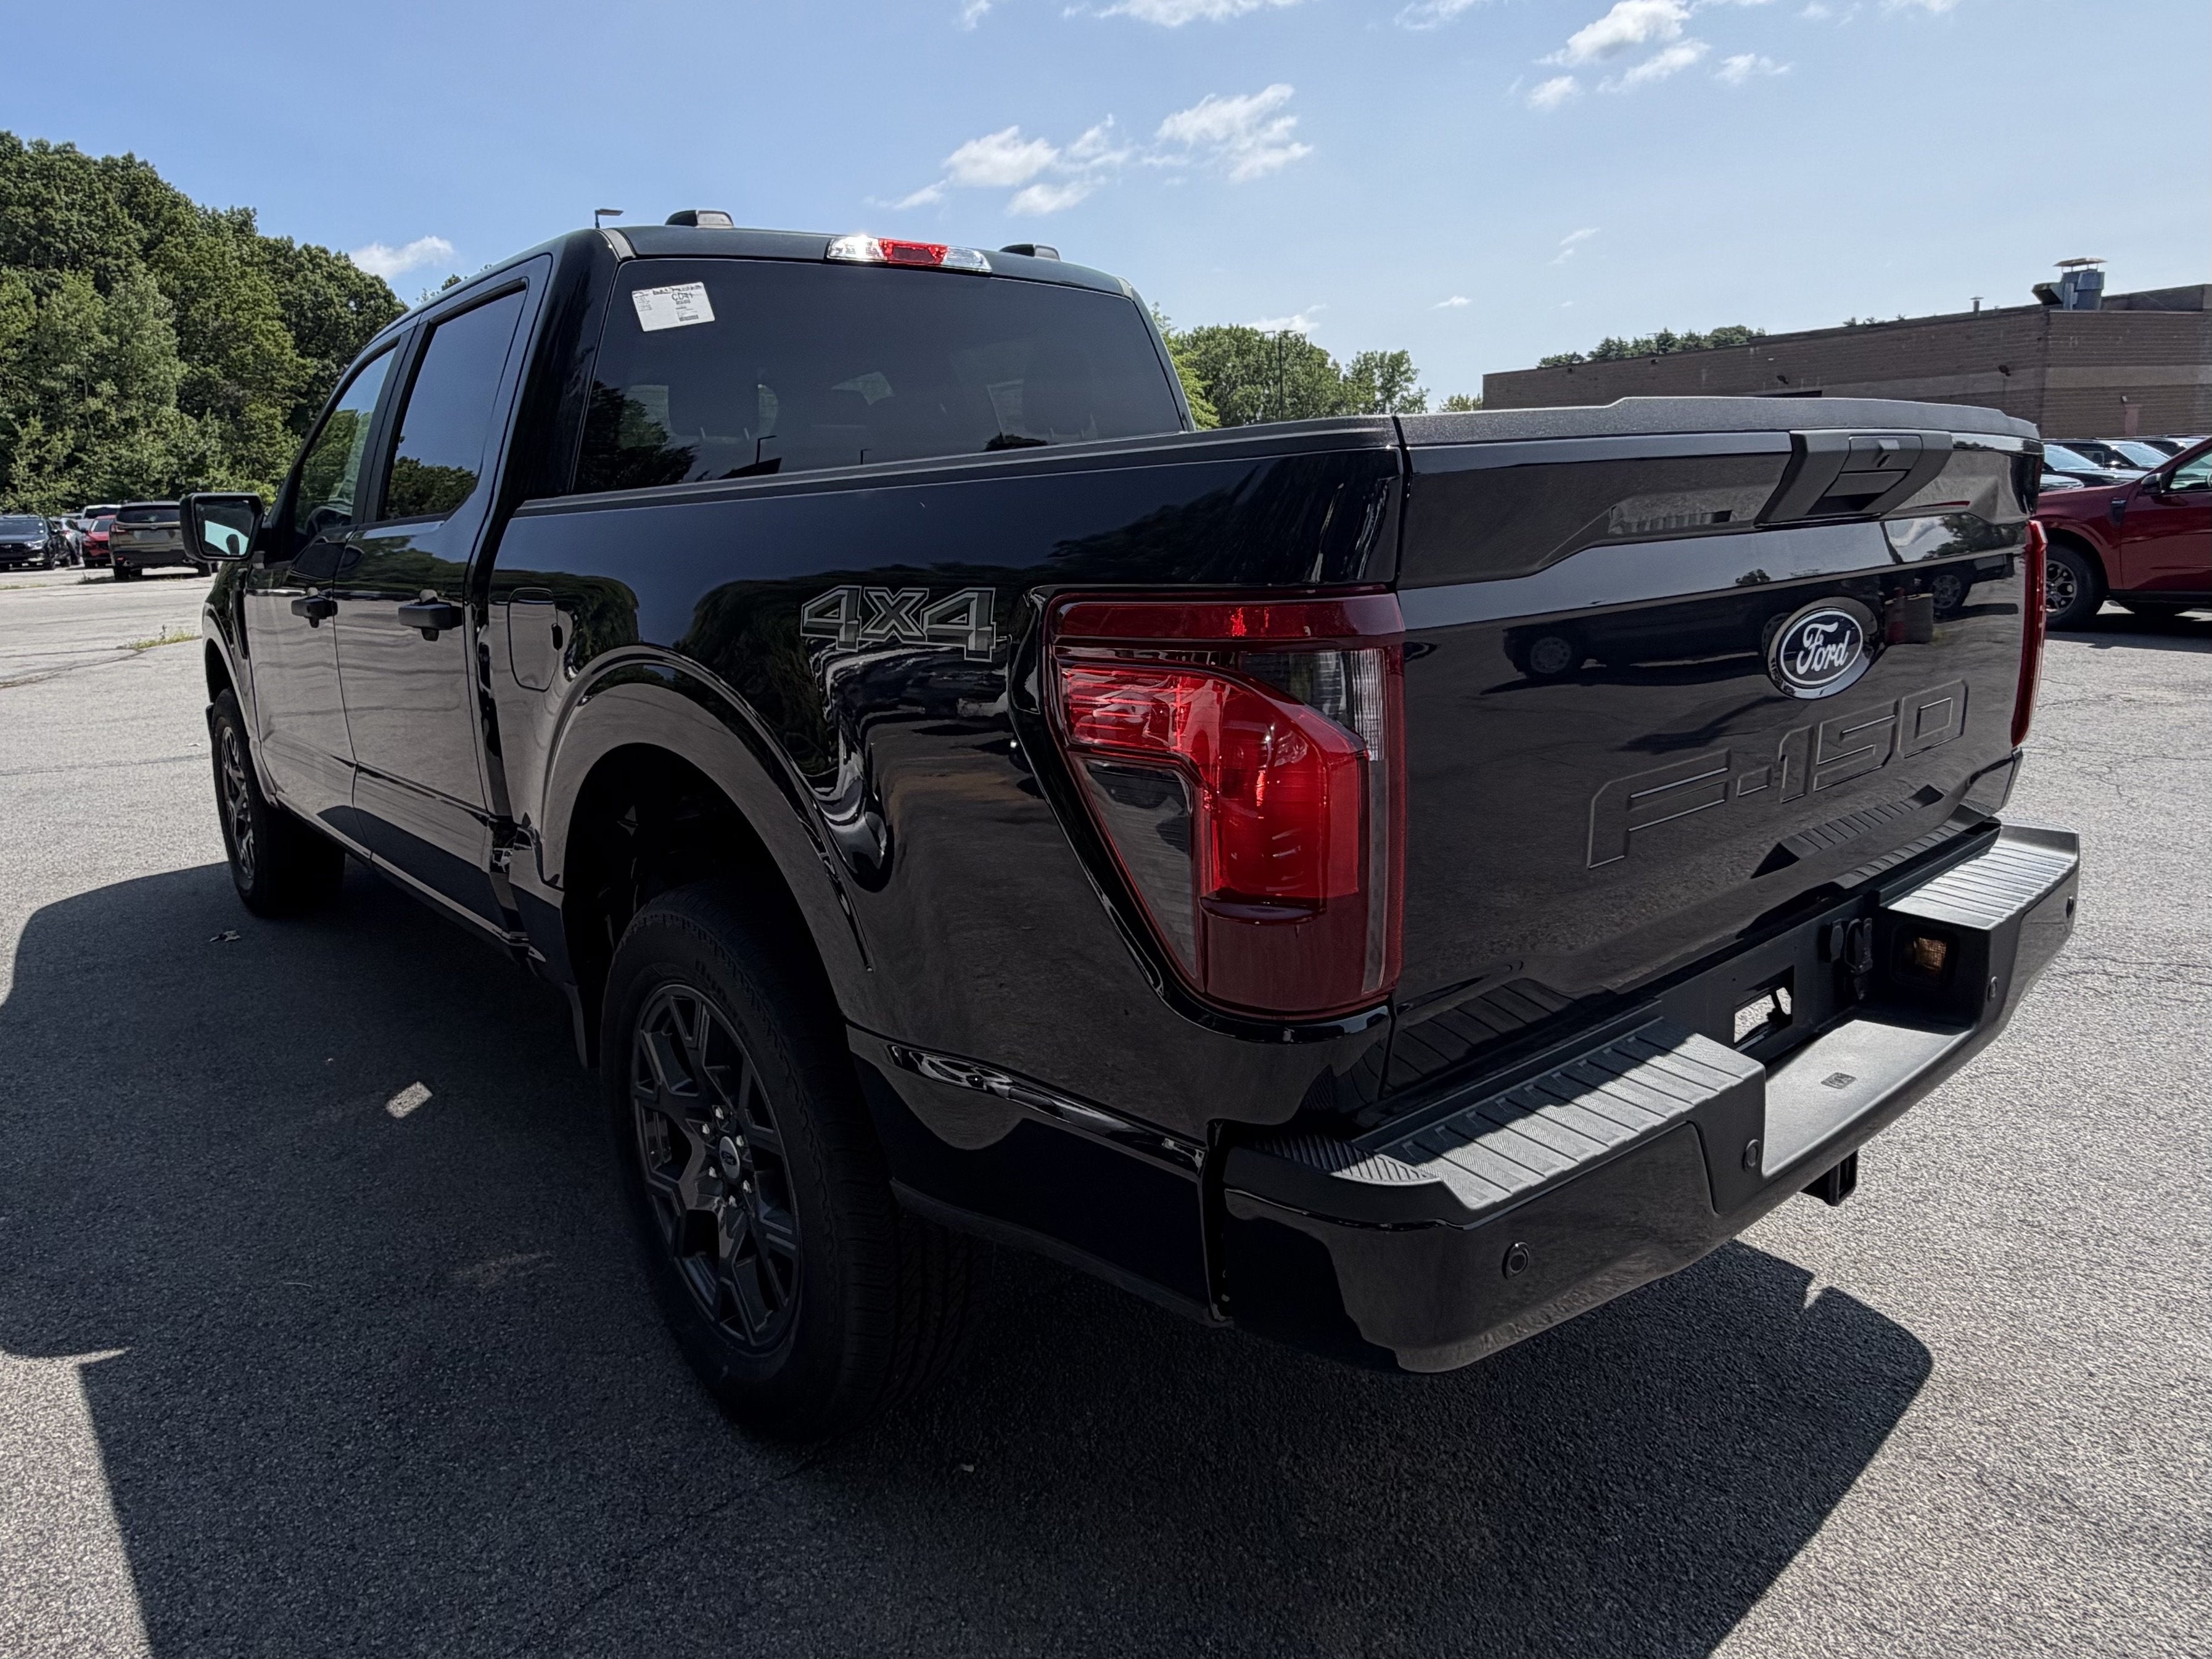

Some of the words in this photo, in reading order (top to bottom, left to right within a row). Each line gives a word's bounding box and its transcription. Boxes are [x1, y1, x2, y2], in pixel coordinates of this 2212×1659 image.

[800, 585, 997, 662] 4X4
[1796, 622, 1851, 675] Ford
[1587, 678, 1970, 870] F-150
